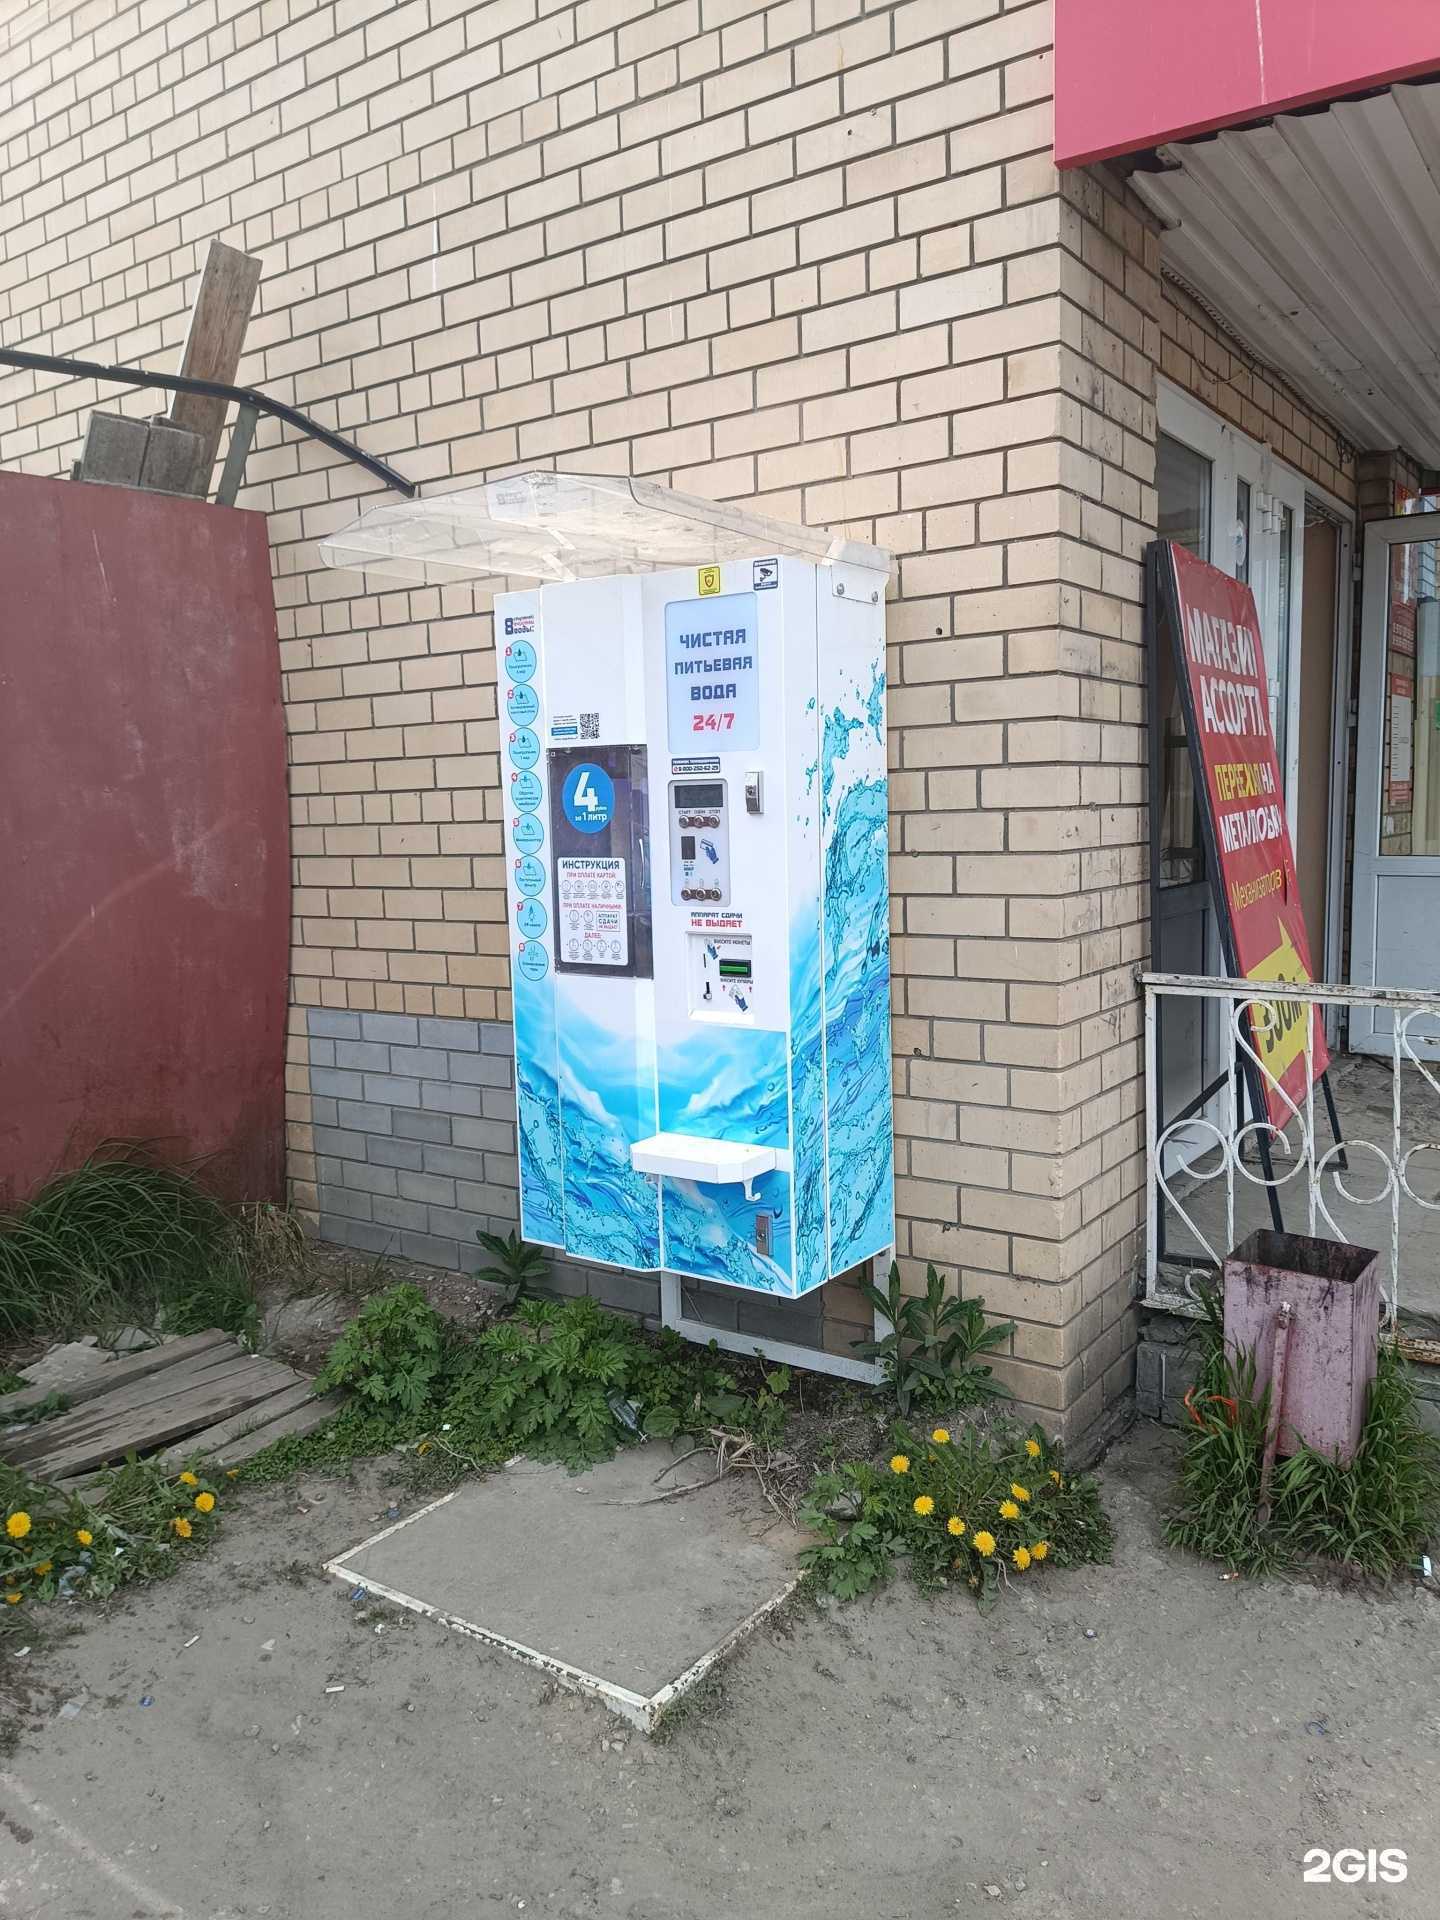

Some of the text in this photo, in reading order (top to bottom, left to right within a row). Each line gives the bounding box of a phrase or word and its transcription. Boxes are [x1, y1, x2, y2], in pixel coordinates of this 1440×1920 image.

[505, 617, 514, 635] 8
[679, 628, 747, 649] ЧИСТАЯ
[674, 656, 753, 675] ПИТЬЕВАЯ
[690, 683, 737, 701] ВОДА
[693, 713, 735, 731] 24/7
[573, 771, 599, 812] 4
[582, 811, 587, 821] 1
[588, 813, 608, 823] литр
[562, 860, 620, 871] ИНСТРУКЦИЯ
[691, 918, 743, 928] НЕ ВЫДАЕТ
